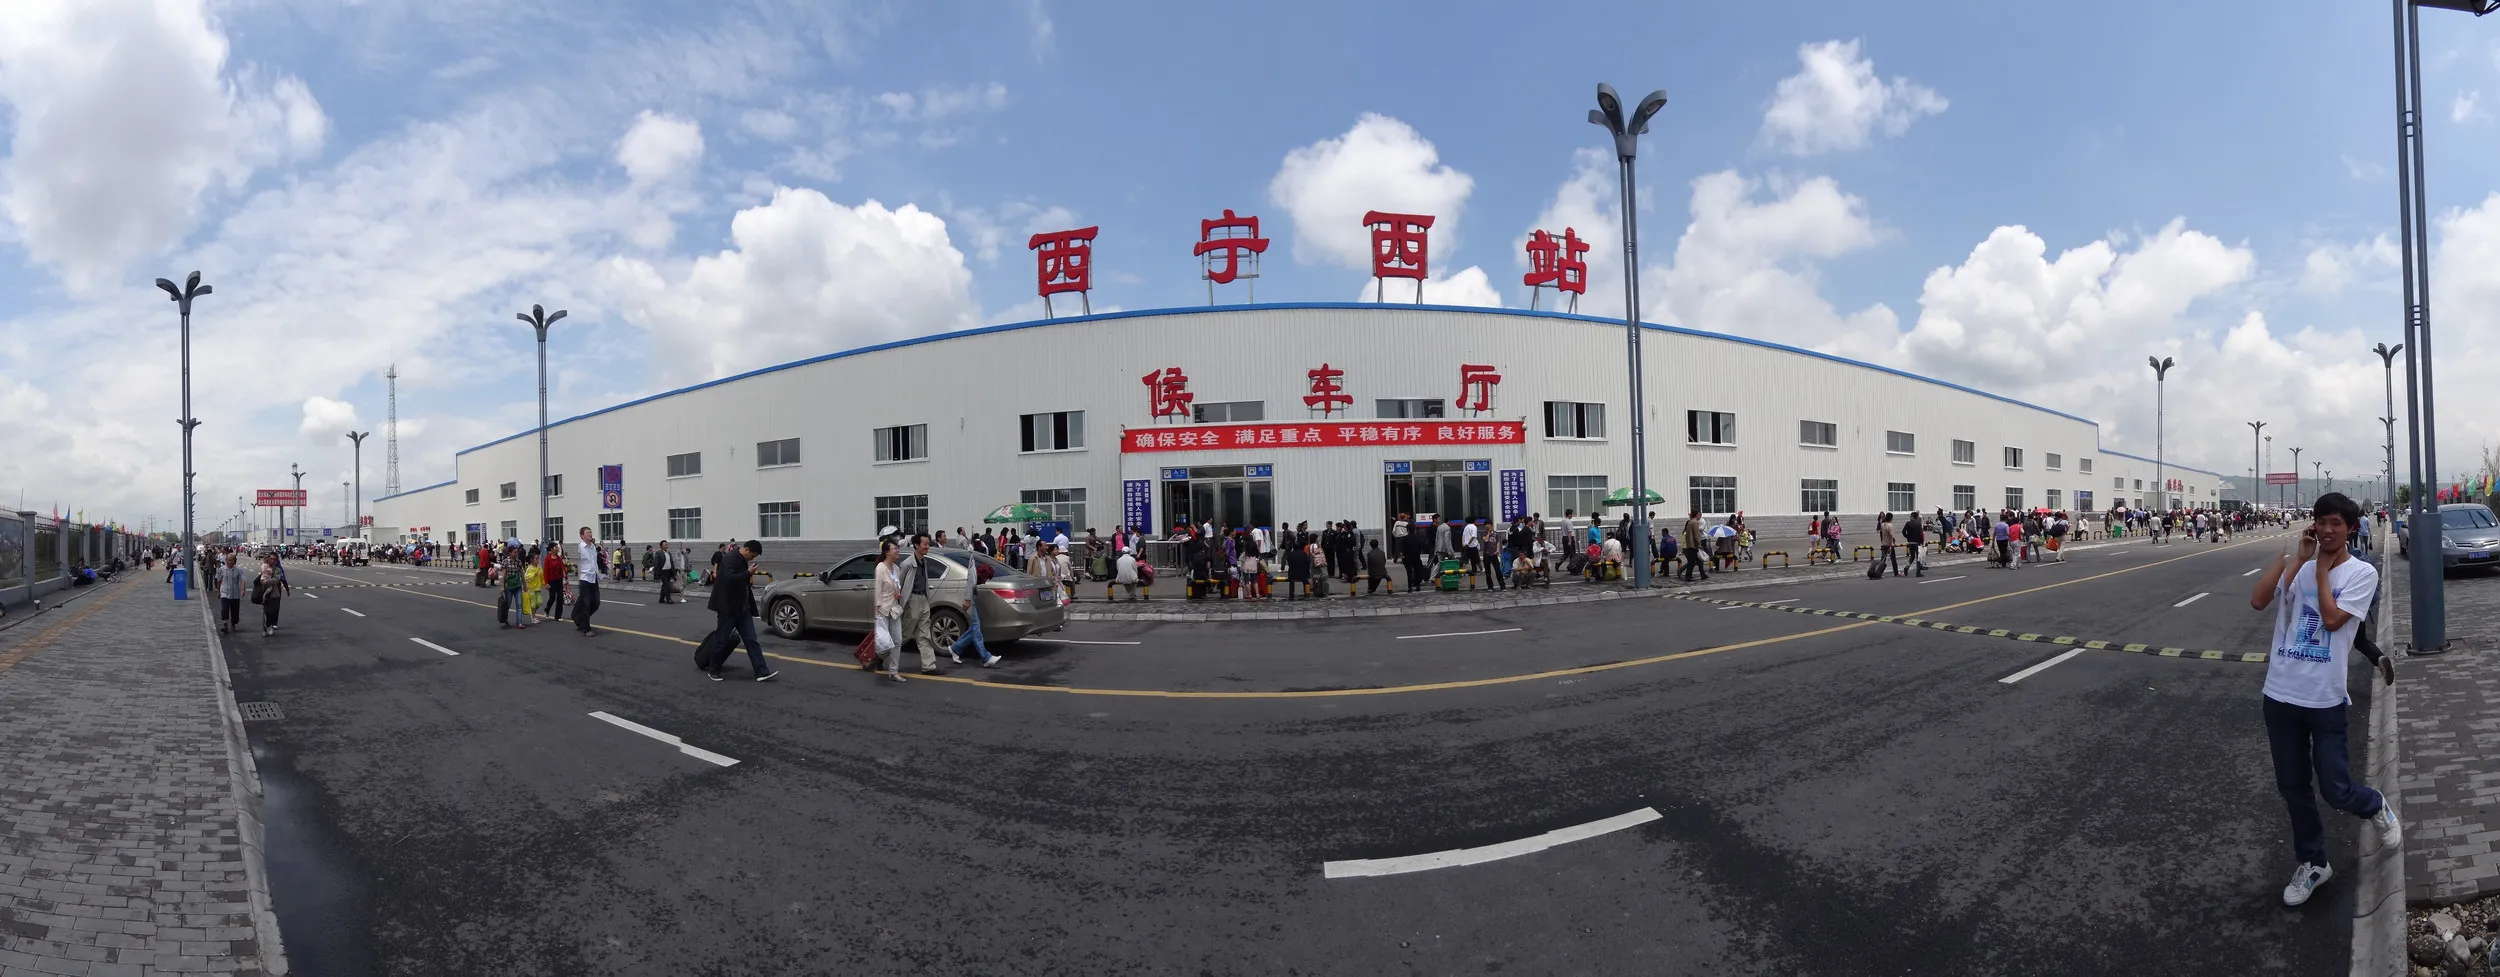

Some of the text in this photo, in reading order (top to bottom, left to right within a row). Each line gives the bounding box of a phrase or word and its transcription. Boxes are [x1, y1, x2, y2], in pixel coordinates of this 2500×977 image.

[1029, 209, 1590, 296] 西宁西站
[1142, 363, 1501, 417] 候车厅
[1135, 425, 1516, 448] 确保安全 满足重点 平稳有序 良好服务
